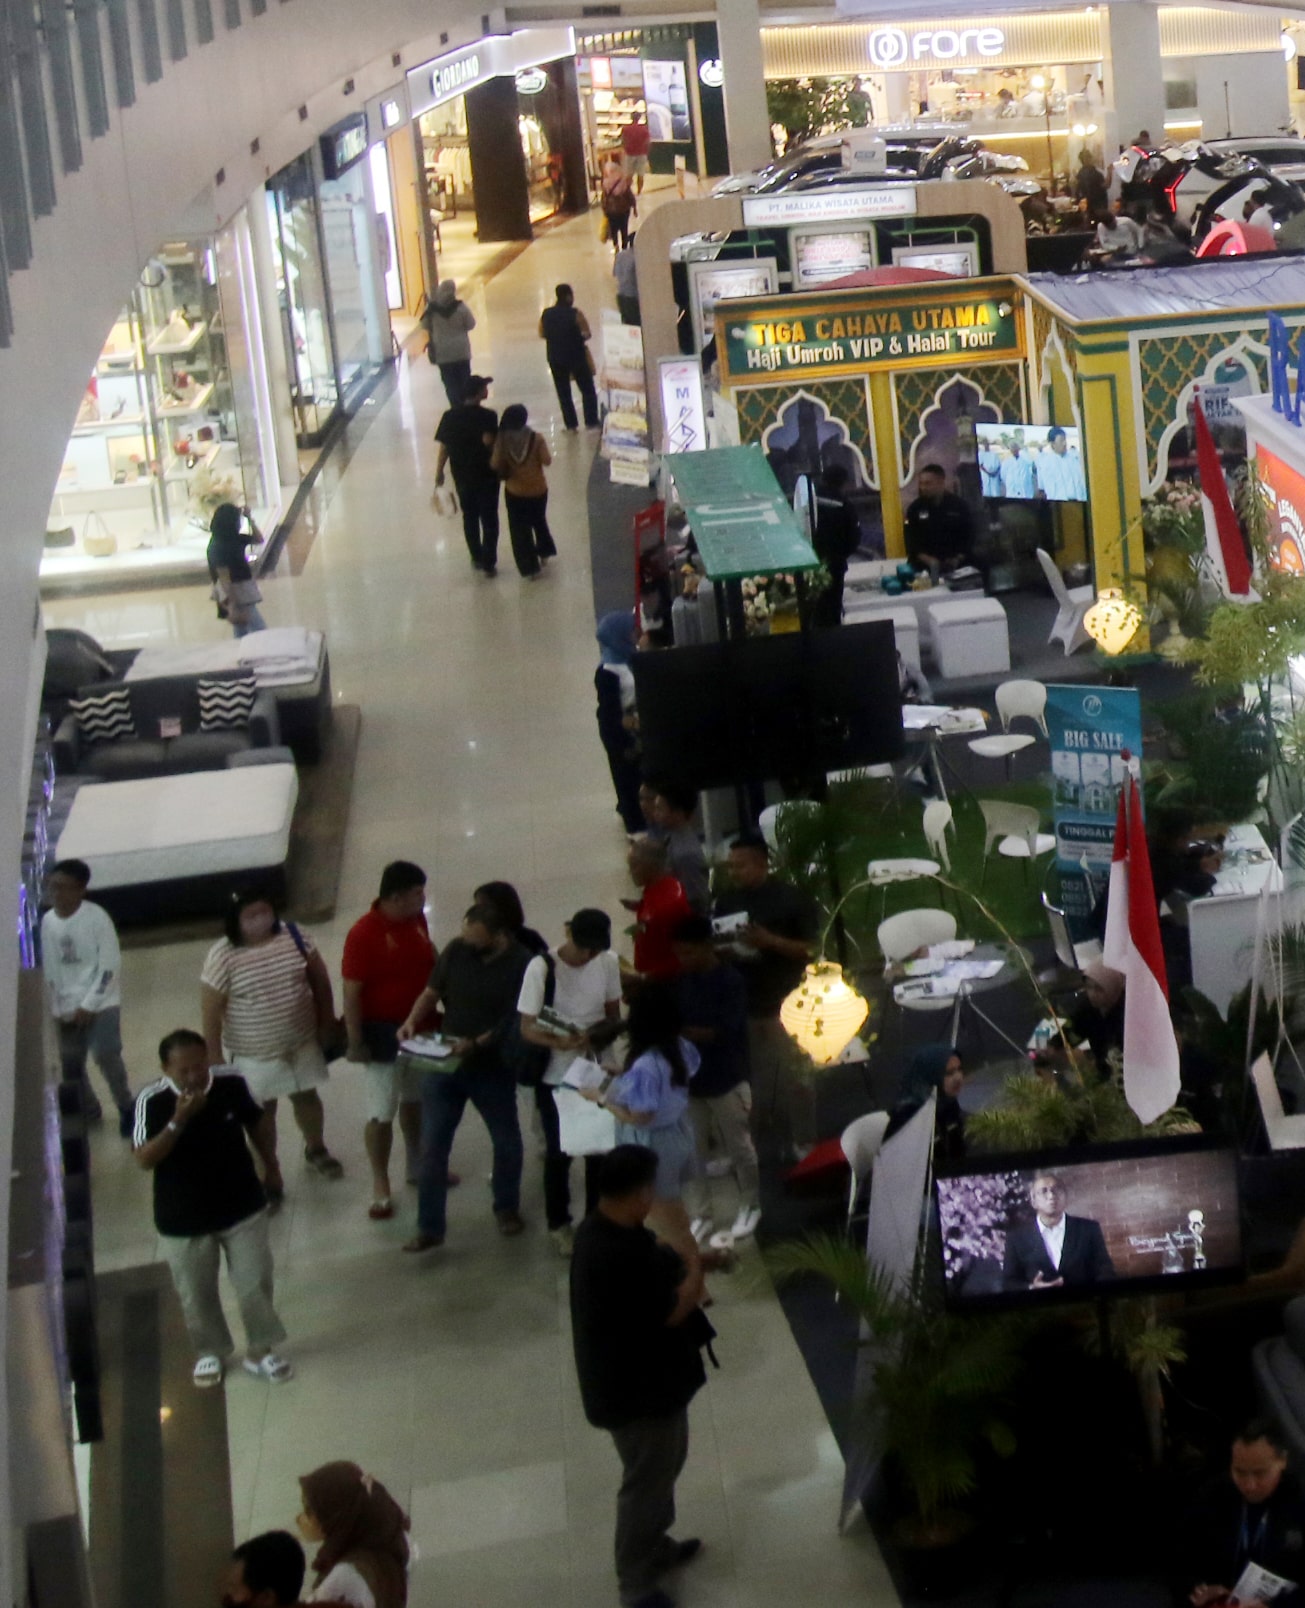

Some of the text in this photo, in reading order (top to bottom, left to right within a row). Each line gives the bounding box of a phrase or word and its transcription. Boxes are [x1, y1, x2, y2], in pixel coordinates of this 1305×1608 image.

[431, 55, 480, 98] GIORDANO
[785, 200, 822, 212] MALIKA
[824, 198, 859, 209] WISATA
[861, 195, 894, 206] UTAMA
[752, 304, 991, 346] TIGA CAHAYA UTAMA
[747, 329, 997, 371] Haji Umroh VIP & Halal Tour
[1064, 730, 1125, 750] BIG SALE
[1064, 825, 1108, 839] TINGGAL
